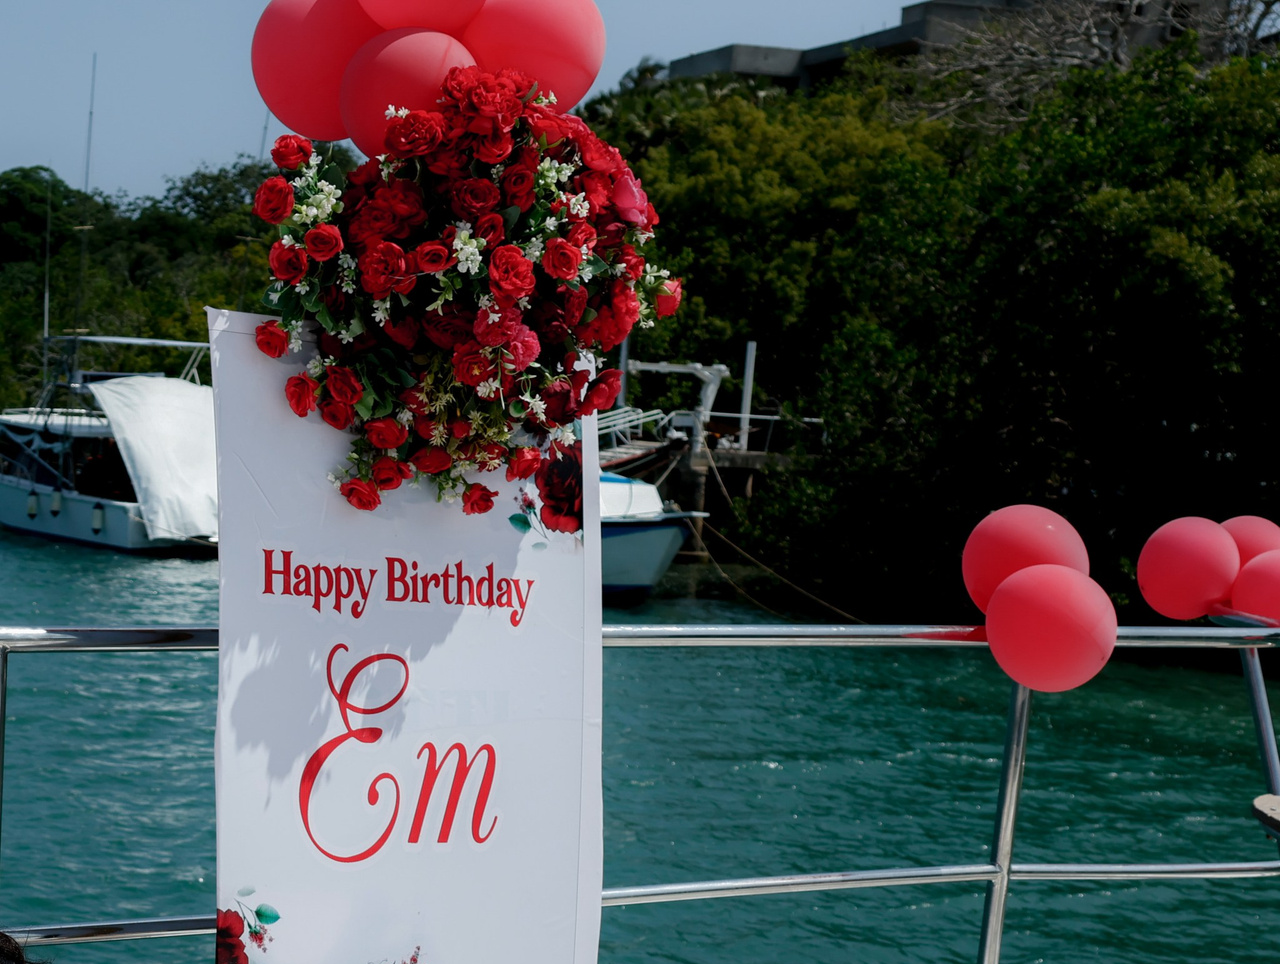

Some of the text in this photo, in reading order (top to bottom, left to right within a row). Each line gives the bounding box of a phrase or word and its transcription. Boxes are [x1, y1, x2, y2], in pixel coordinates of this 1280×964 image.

[262, 548, 535, 627] Happy Birthday
[299, 643, 498, 863] Em
